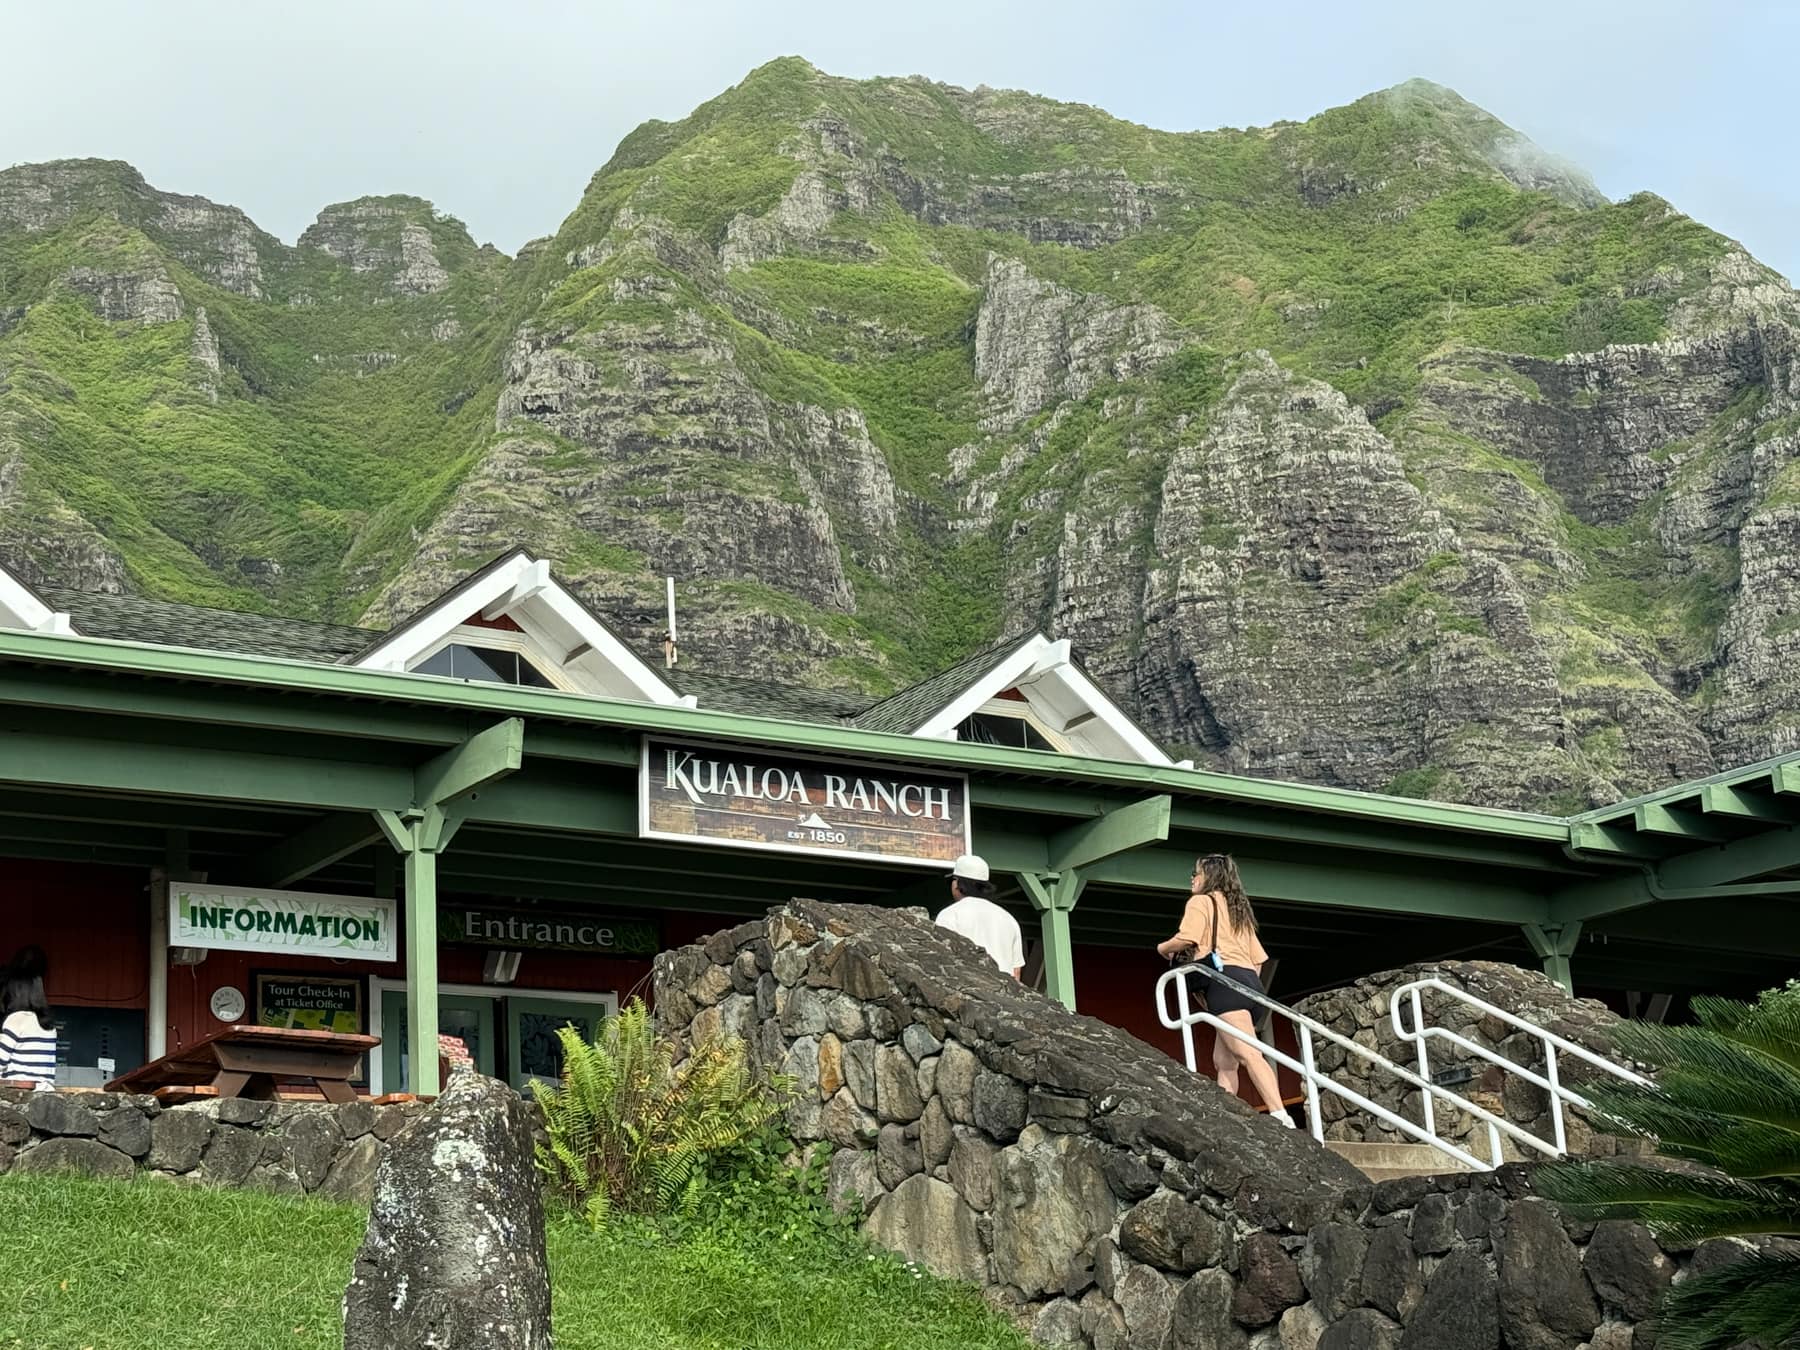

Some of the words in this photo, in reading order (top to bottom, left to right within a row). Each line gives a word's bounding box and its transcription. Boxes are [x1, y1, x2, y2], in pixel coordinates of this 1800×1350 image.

[663, 749, 812, 805] KUALOA
[823, 774, 952, 821] RANCH
[810, 830, 846, 843] 1850
[190, 905, 380, 942] INFORMATION
[465, 911, 615, 946] Entrance
[268, 984, 295, 995] Tour
[298, 985, 350, 999] Check-In
[274, 999, 284, 1007] at
[287, 998, 314, 1008] Ticket
[316, 999, 344, 1010] Office
